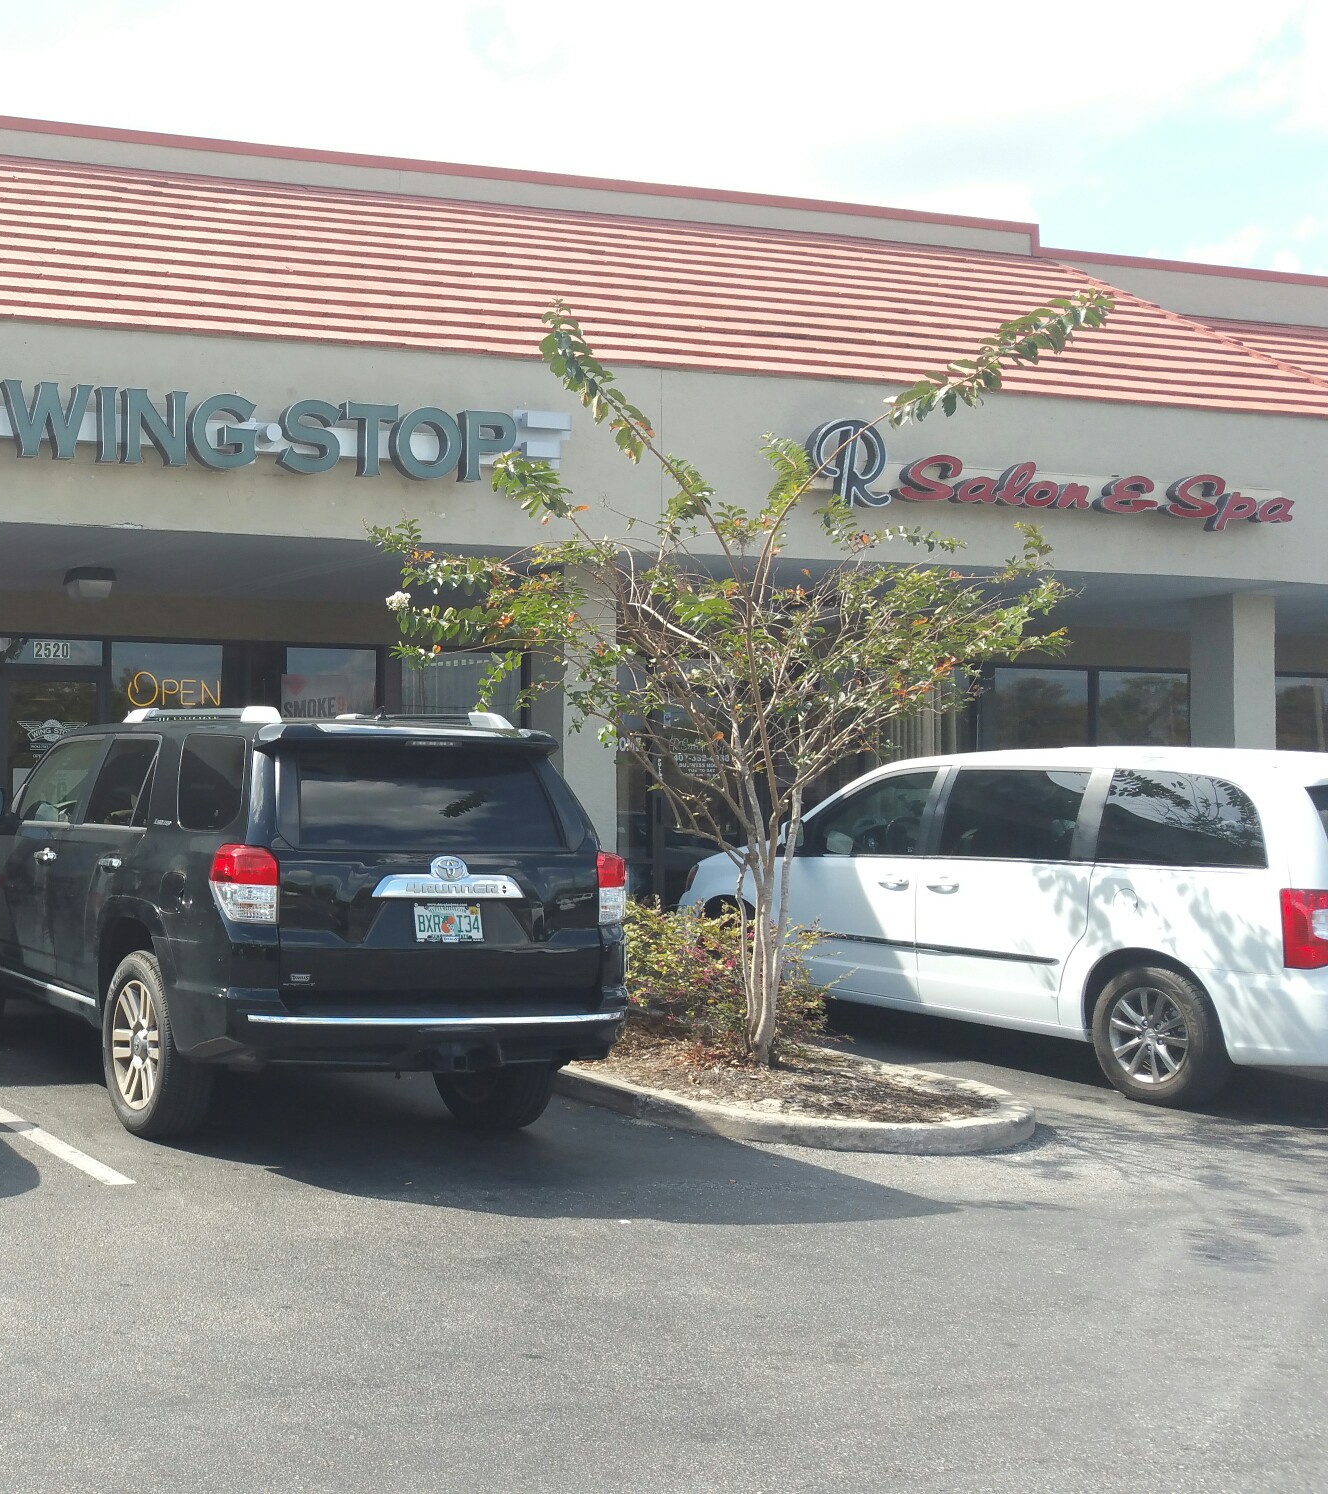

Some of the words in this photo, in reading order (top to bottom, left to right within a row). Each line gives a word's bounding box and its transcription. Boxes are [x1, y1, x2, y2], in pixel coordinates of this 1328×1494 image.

[274, 398, 519, 483] STOP
[890, 453, 1090, 510] Salon
[1094, 474, 1159, 514] &
[1159, 473, 1296, 532] Spa
[34, 642, 70, 658] 2520
[127, 671, 221, 707] OPEN
[283, 696, 337, 718] SMOKE
[31, 728, 52, 738] WING
[406, 883, 499, 894] 4RUNNER
[418, 915, 441, 933] BXR
